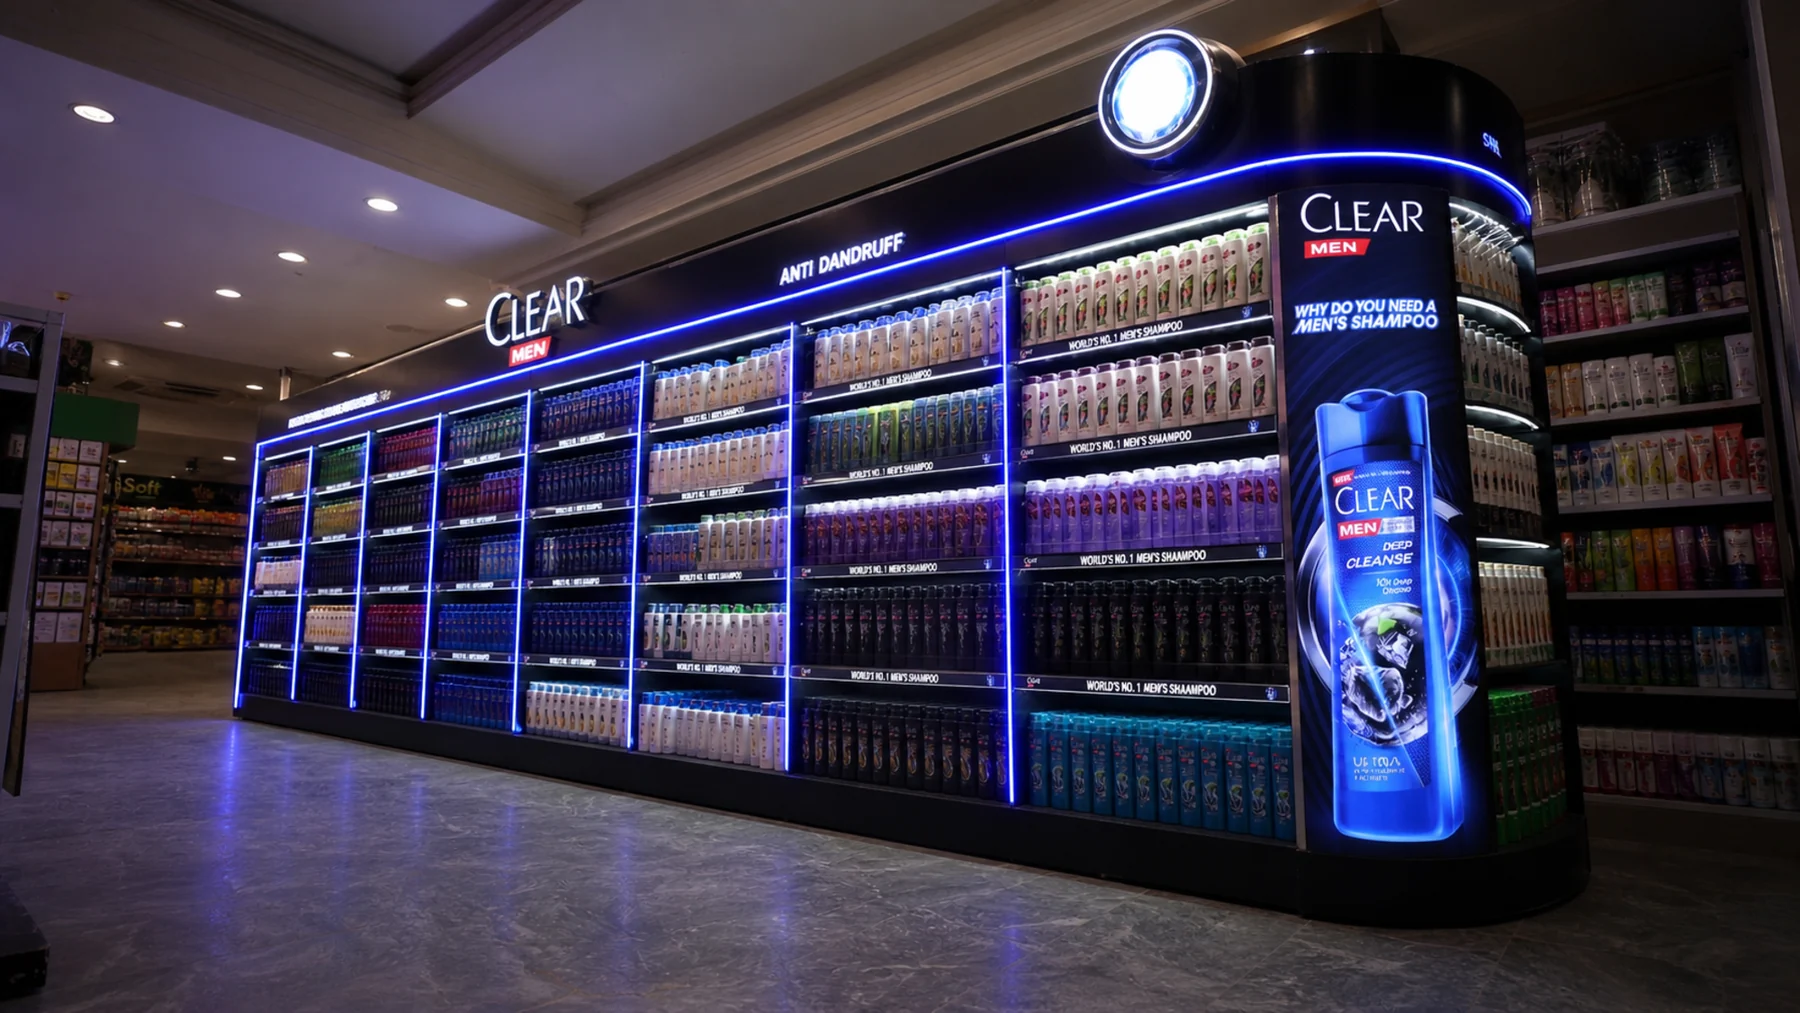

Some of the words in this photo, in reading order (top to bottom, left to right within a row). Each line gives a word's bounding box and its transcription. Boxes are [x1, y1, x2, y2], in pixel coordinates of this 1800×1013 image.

[1300, 192, 1424, 233] CLEAR
[1311, 241, 1357, 255] MEN
[779, 260, 813, 286] ANTI
[819, 232, 905, 274] DANDRUFF
[485, 276, 585, 346] CLEAR
[1294, 302, 1329, 318] WHY
[1330, 300, 1353, 315] DO
[1355, 299, 1386, 313] YOU
[1388, 299, 1423, 313] NEED
[1425, 299, 1437, 313] A
[1292, 316, 1348, 335] MEN'S
[1351, 314, 1438, 330] SHAMPOO
[511, 340, 547, 364] MEN
[1068, 337, 1099, 350] WORLD'S
[1069, 441, 1102, 454] WORLD'S
[1334, 485, 1415, 515] CLEAR
[1340, 522, 1378, 537] MEN
[1080, 554, 1114, 566] WORLD'S
[1115, 553, 1128, 564] NO.
[1346, 552, 1414, 569] CLEANSE
[1086, 680, 1120, 692] WORLD'S
[1121, 681, 1135, 693] NO.
